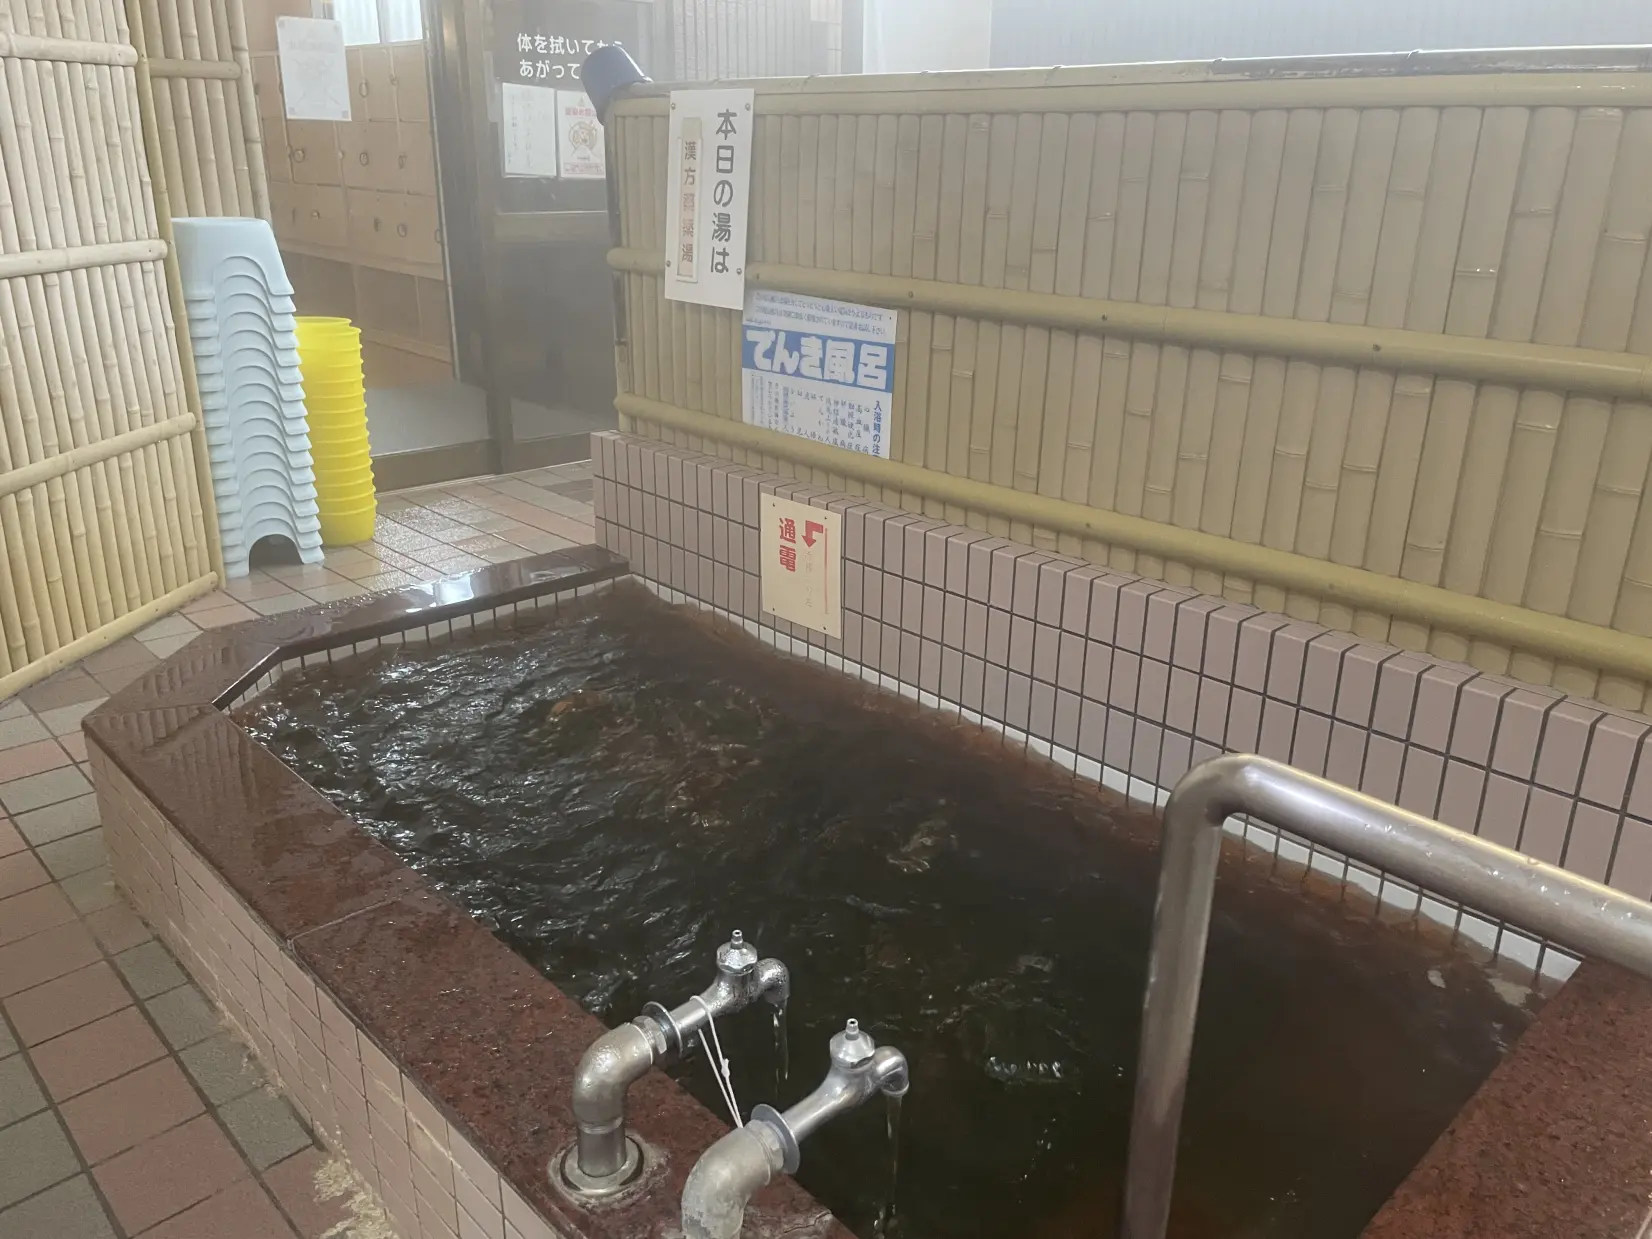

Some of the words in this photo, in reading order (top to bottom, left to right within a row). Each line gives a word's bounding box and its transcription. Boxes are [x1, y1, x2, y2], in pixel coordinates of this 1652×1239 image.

[710, 108, 738, 274] 本日の湯は
[745, 329, 888, 390] でんき風呂
[872, 400, 882, 457] 入浴時の注
[778, 517, 797, 573] 通電
